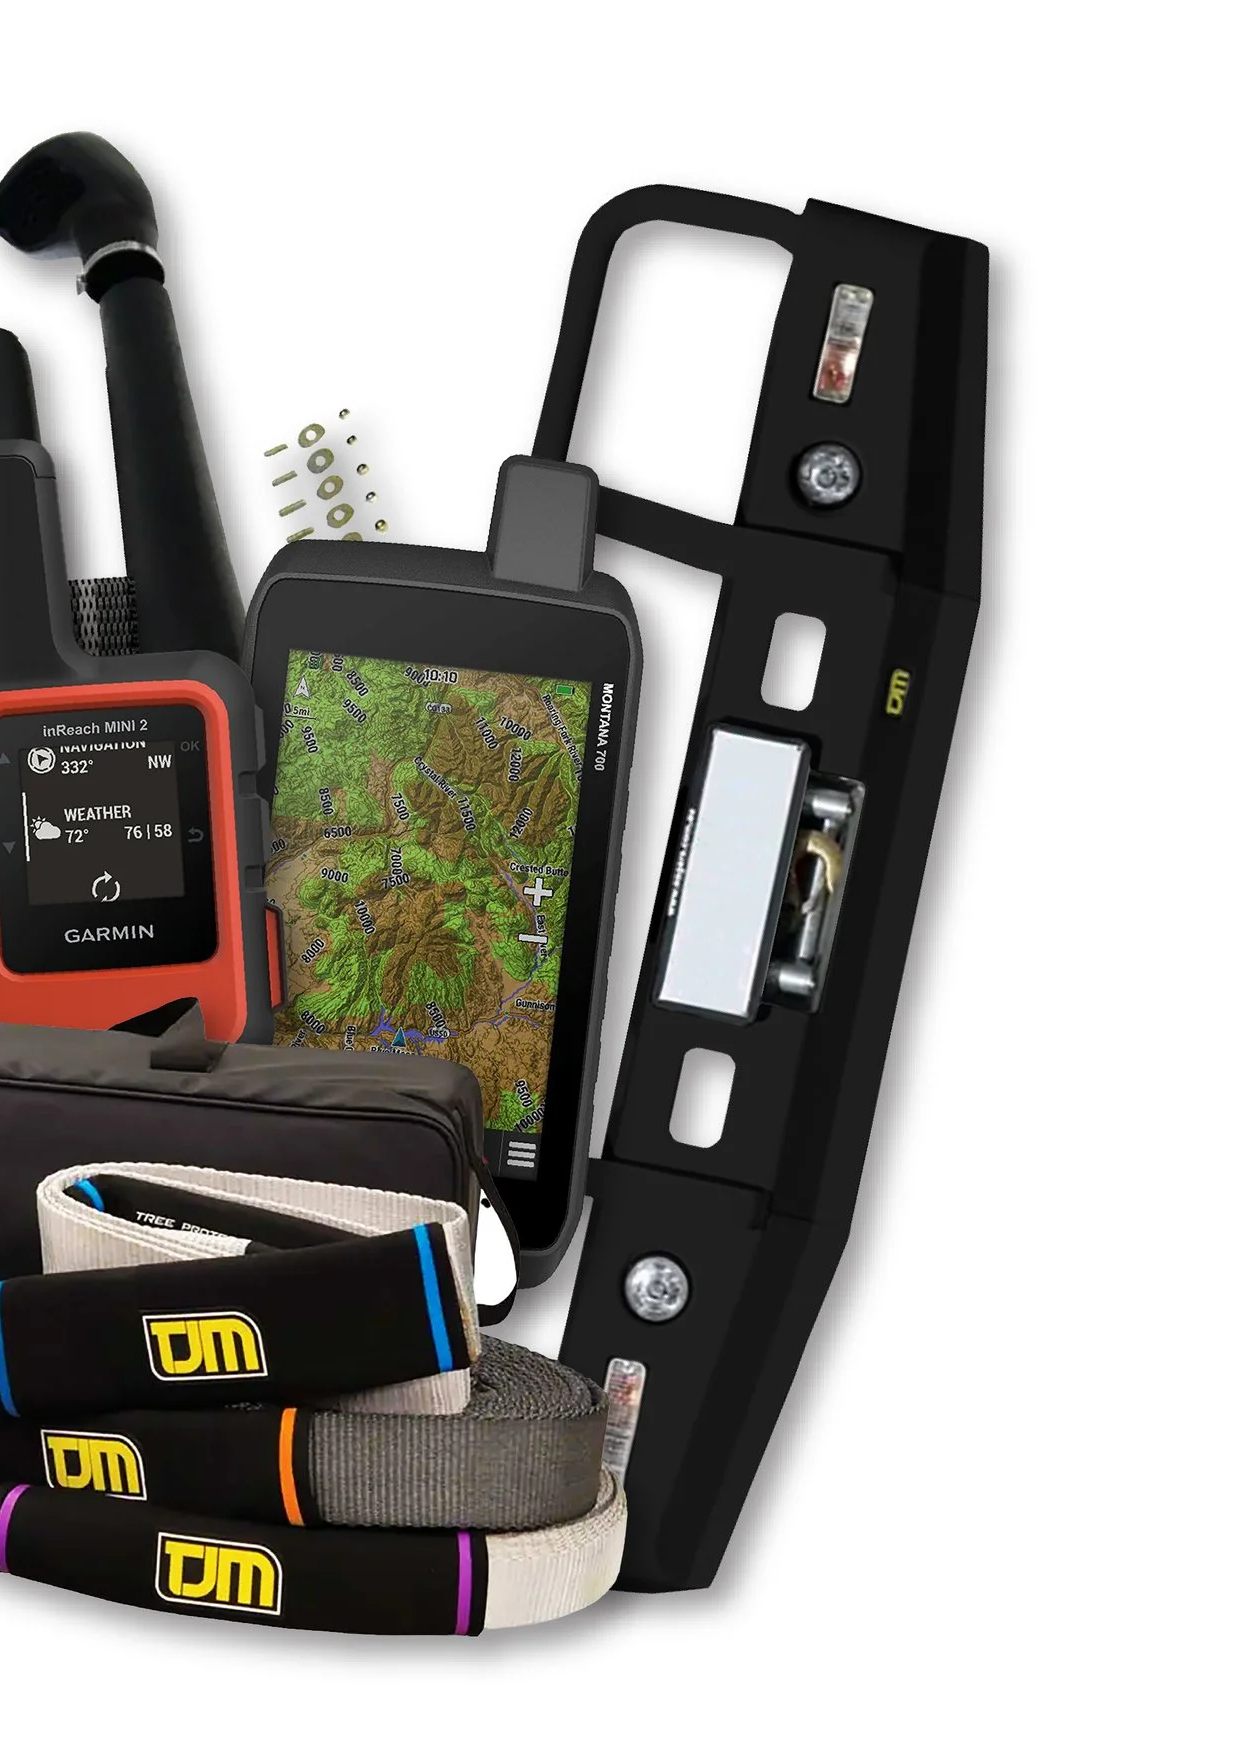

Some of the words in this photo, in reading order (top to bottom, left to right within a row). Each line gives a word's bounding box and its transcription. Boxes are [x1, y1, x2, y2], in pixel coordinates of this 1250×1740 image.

[347, 670, 368, 696] 8500
[425, 669, 457, 683] 10:10
[342, 699, 367, 723] 9500
[542, 694, 561, 726] Roaring
[558, 726, 572, 746] Fork
[597, 683, 614, 747] MONTANA
[43, 722, 100, 737] inReach
[104, 720, 135, 734] MINI
[139, 719, 148, 731] 2
[301, 726, 318, 753] 9500
[475, 717, 498, 749] 11000
[501, 717, 532, 740] 10000
[180, 741, 200, 752] OK
[61, 759, 94, 775] 332°
[148, 754, 172, 769] NW
[508, 748, 522, 782] 12000
[594, 750, 607, 771] 700
[413, 756, 440, 785] Crystal
[438, 780, 457, 799] River
[64, 805, 132, 822] WEATHER
[318, 788, 334, 816] 8500
[391, 793, 409, 820] 7500
[457, 797, 476, 831] 11500
[65, 829, 89, 844] 72°
[124, 826, 142, 839] 76
[154, 824, 172, 838] 58
[324, 826, 351, 839] 6500
[509, 808, 533, 838] 12000
[321, 868, 349, 883] 9000
[510, 862, 543, 874] Crested
[382, 874, 409, 889] 7500
[355, 900, 376, 935] 10000
[64, 925, 154, 943] GARMIN
[302, 938, 325, 963] 8000
[426, 1001, 446, 1028] 8500
[516, 999, 555, 1010] Gunnison
[301, 1010, 325, 1034] 8000
[515, 1080, 532, 1107] 9500
[136, 1211, 175, 1228] TREE
[181, 1222, 228, 1238] PRO
[150, 1318, 259, 1374] TJM
[47, 1436, 140, 1494] TJM
[165, 1540, 275, 1607] TJM
